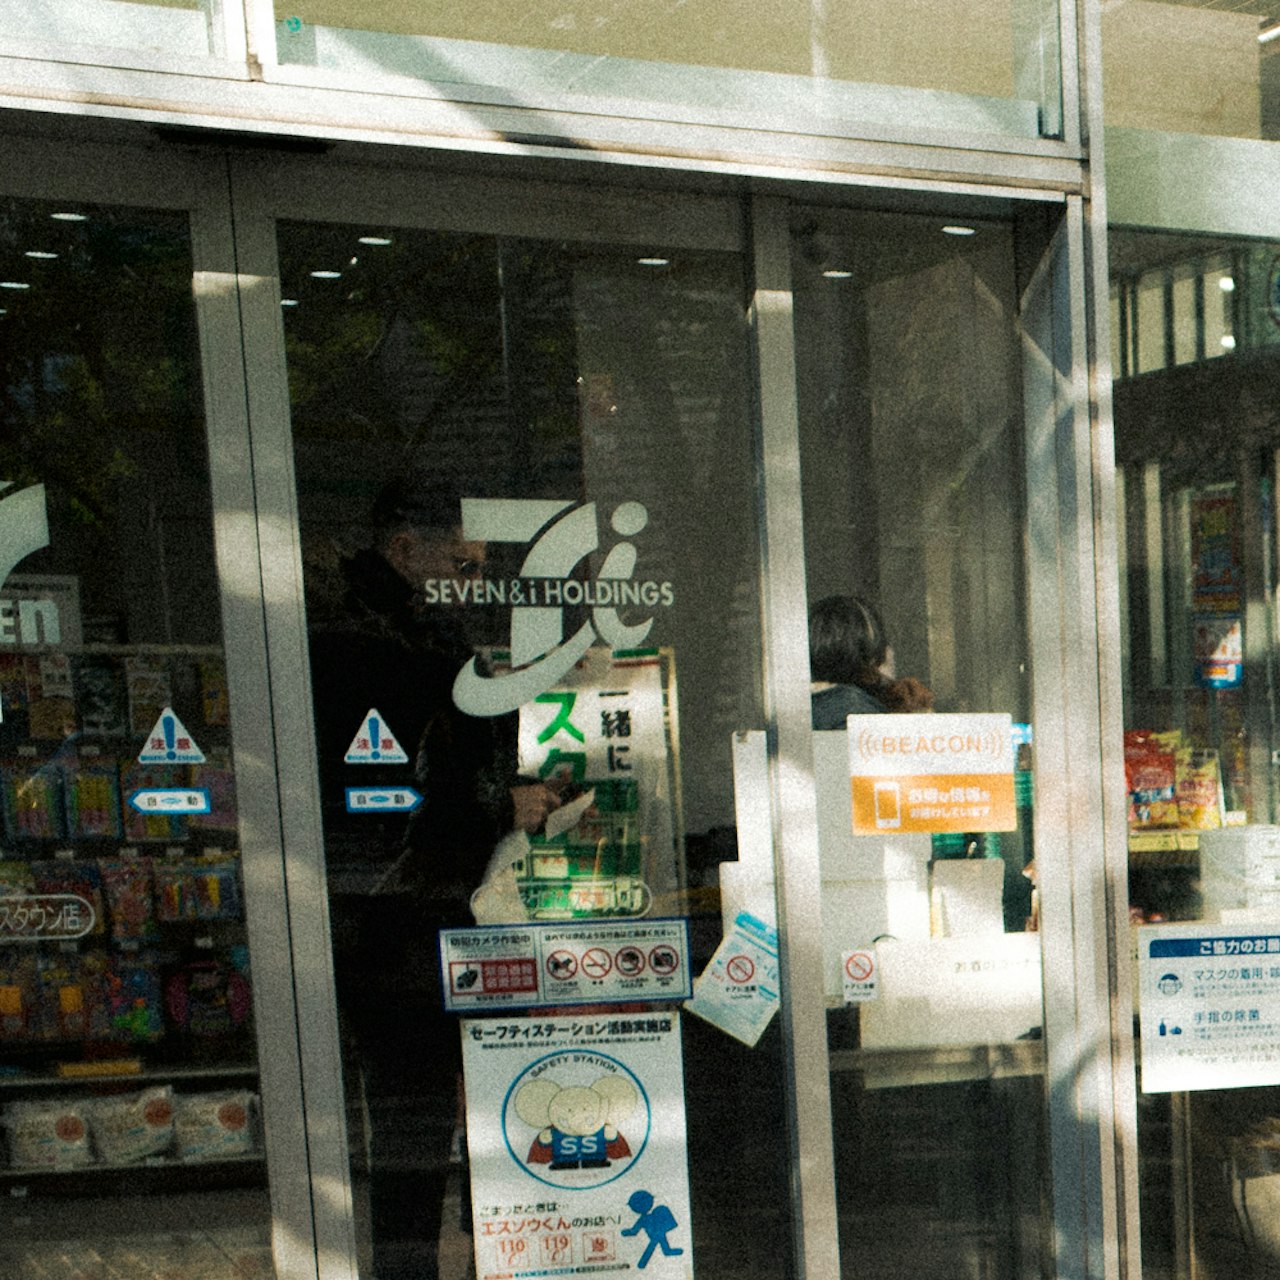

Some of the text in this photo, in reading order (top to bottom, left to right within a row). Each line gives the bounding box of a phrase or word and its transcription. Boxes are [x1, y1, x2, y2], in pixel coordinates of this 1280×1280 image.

[425, 579, 507, 605] SEVEN
[544, 579, 675, 606] HOLDINGS
[598, 691, 632, 773] 一緒に
[882, 735, 983, 754] BEACON
[1194, 1009, 1260, 1024] 手指の除菌
[469, 1018, 673, 1042] セーフティステーション活動実施店
[529, 1055, 619, 1078] SAFETY STATION
[499, 1236, 569, 1253] 110 119
